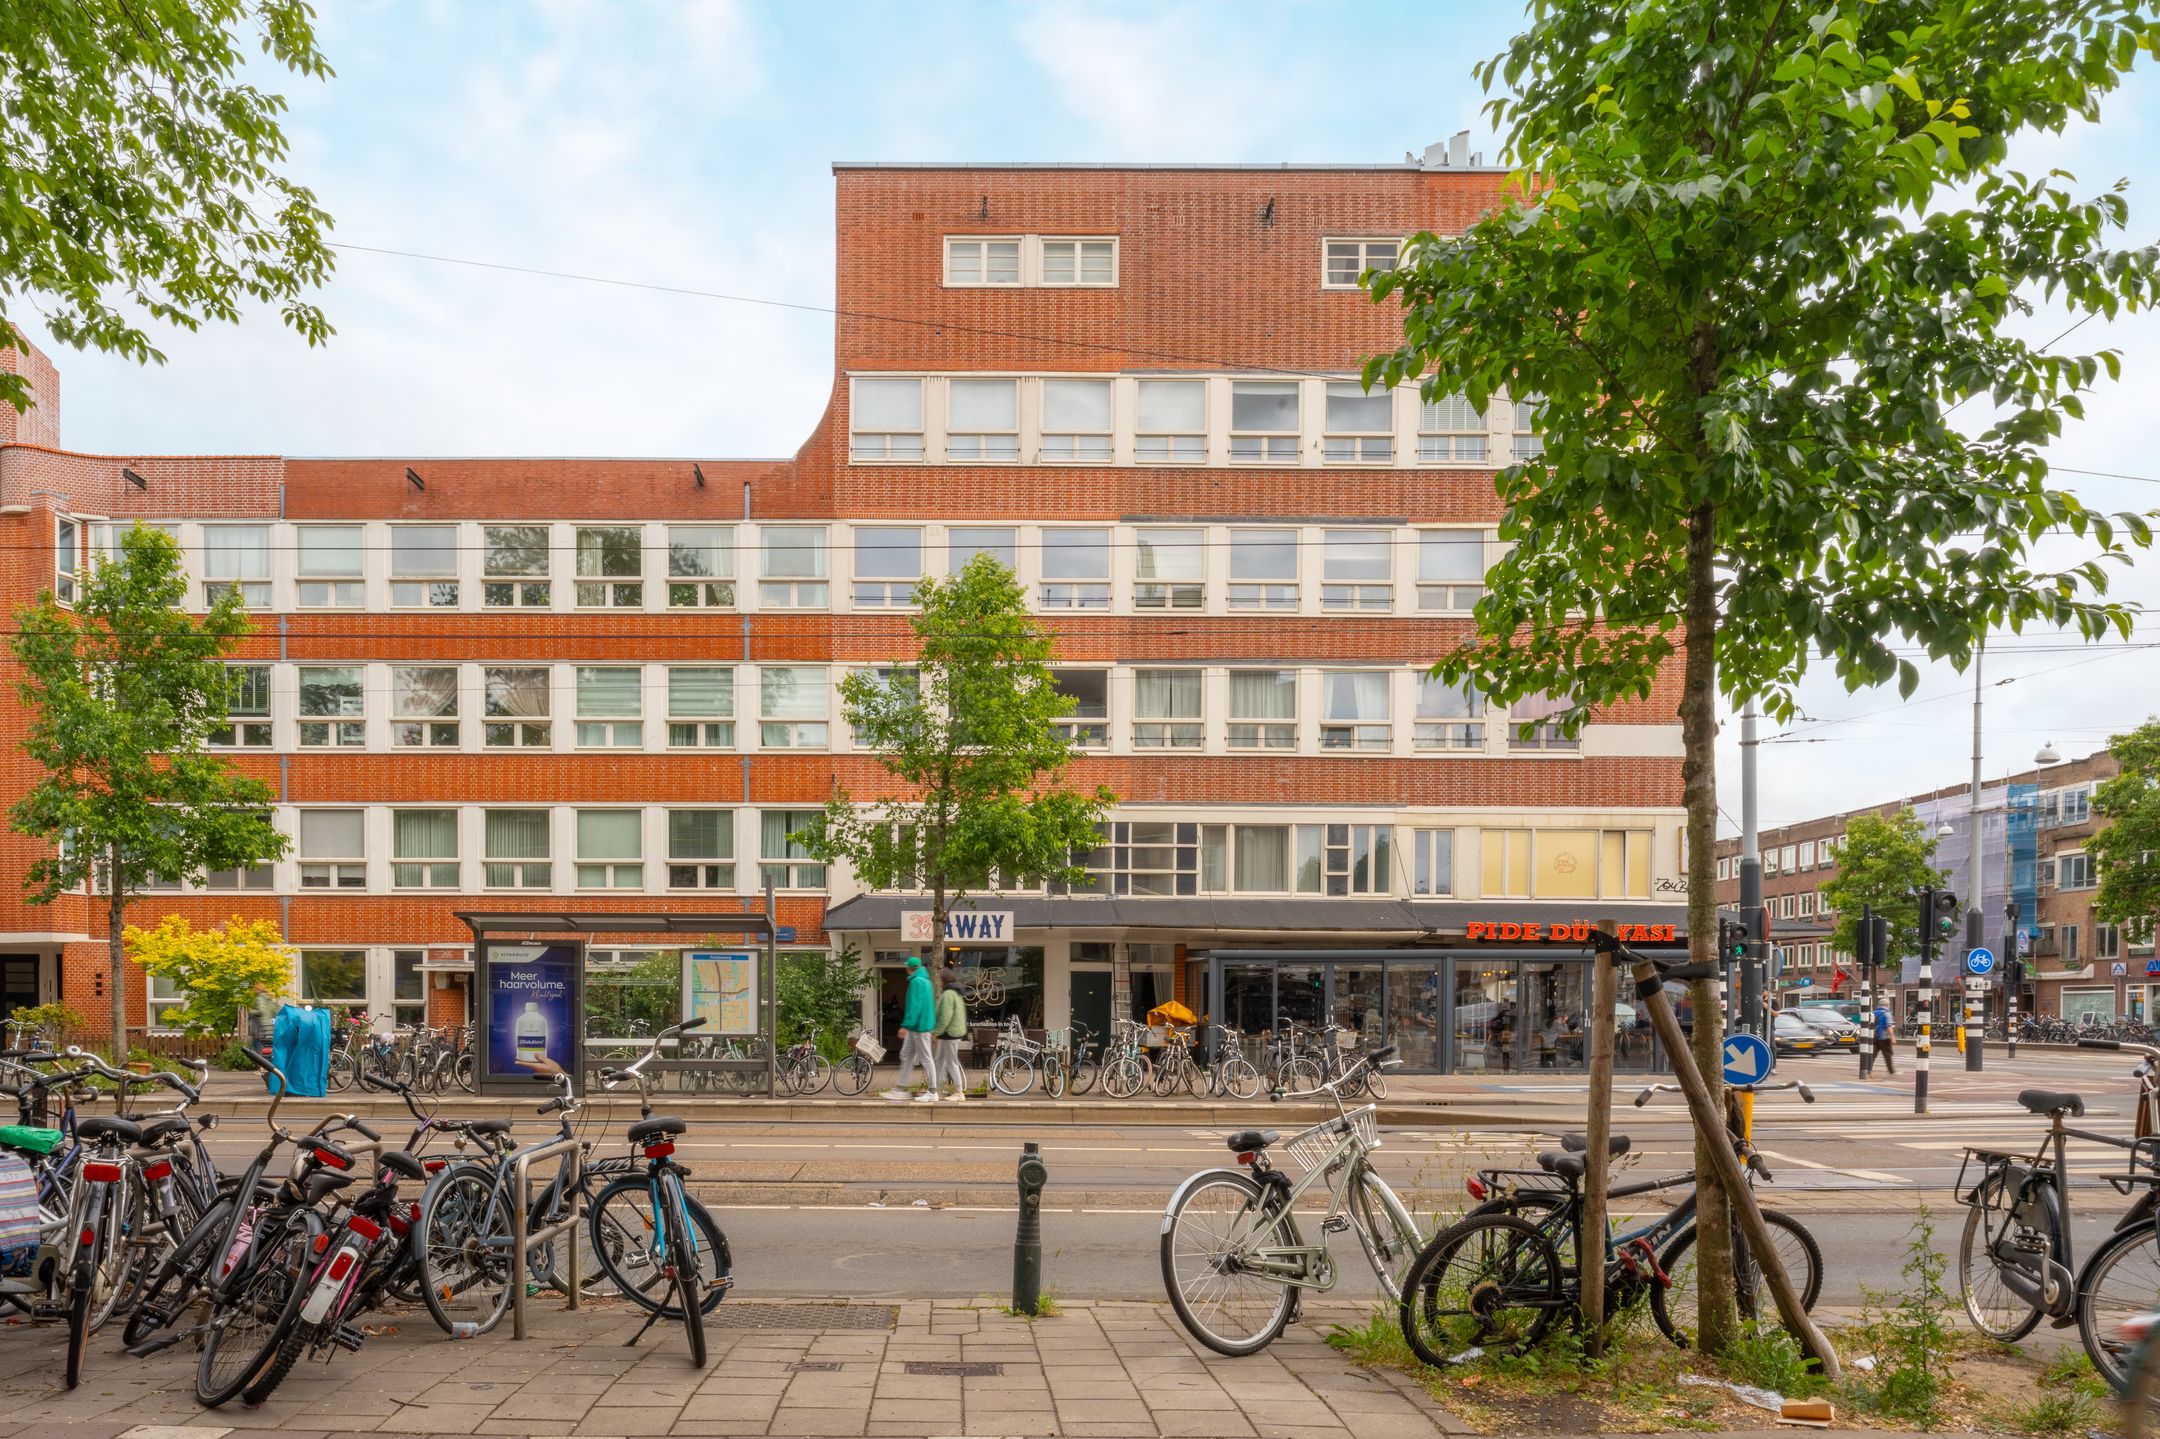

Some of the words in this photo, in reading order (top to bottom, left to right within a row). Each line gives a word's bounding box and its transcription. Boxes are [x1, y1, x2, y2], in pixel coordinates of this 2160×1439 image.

[1466, 921, 1541, 941] PIDE
[1549, 918, 1677, 942] DÜYASI
[510, 971, 538, 981] Meer
[499, 979, 566, 990] haarvolume.
